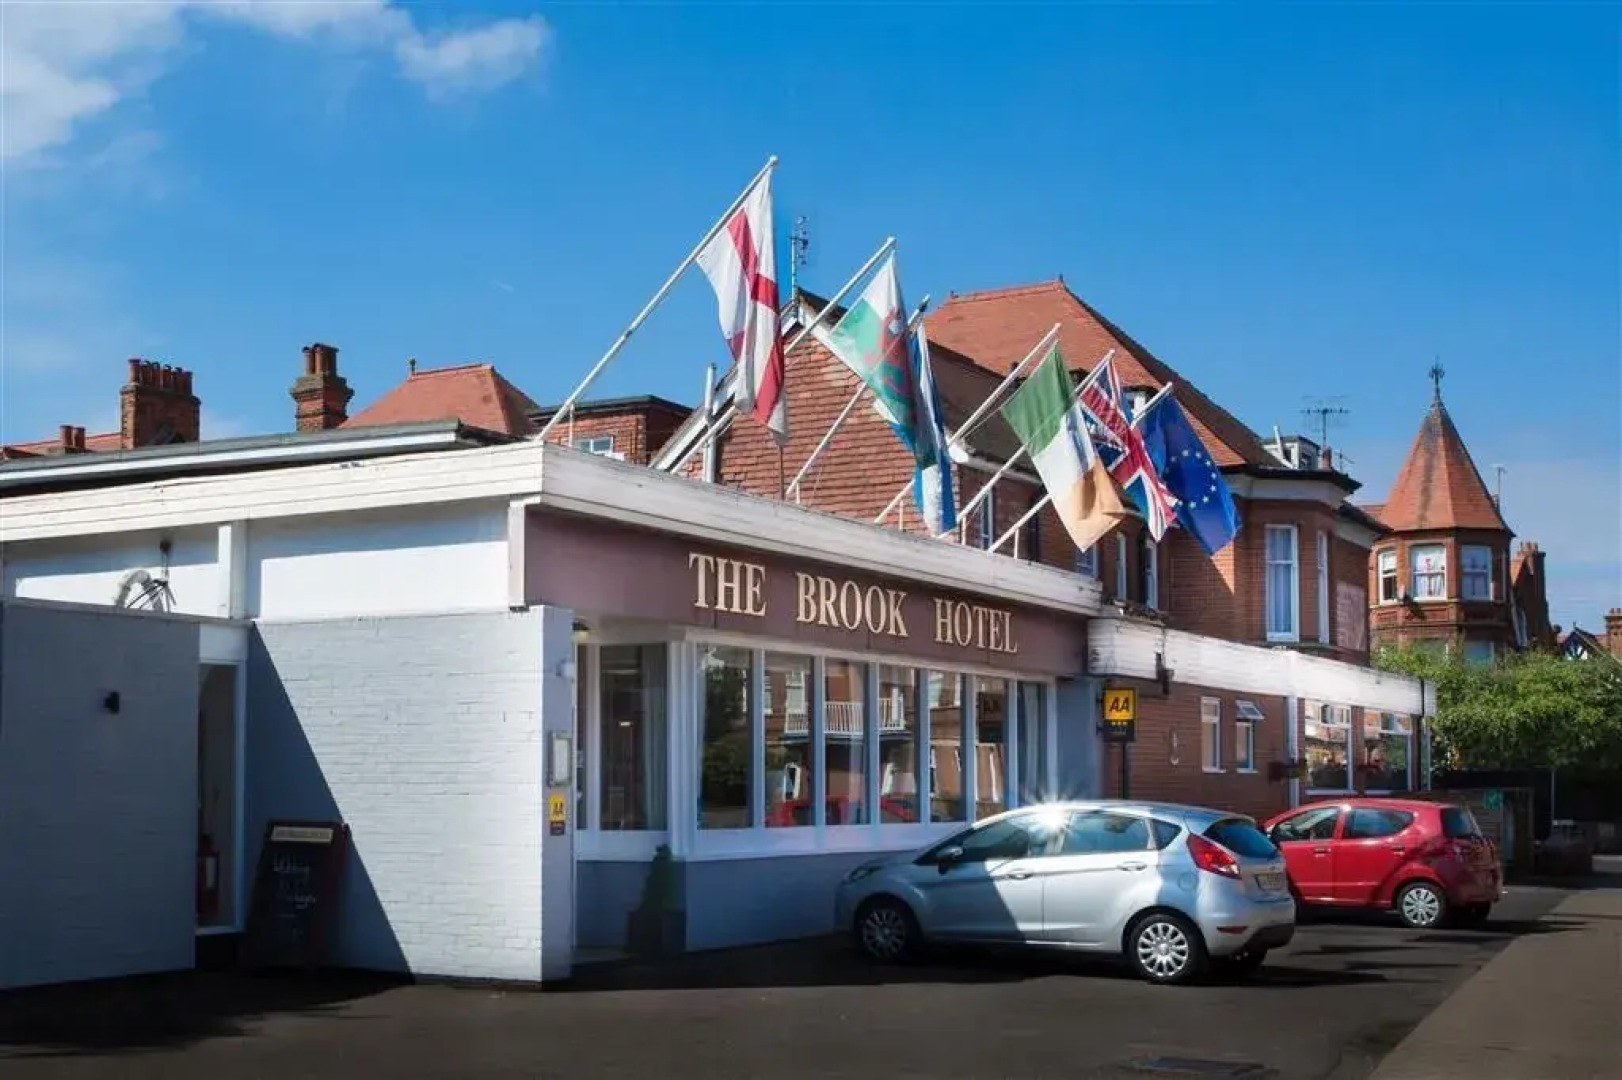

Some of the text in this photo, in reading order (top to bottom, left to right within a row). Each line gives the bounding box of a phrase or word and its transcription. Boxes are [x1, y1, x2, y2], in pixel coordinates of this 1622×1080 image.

[689, 552, 1018, 653] THE BROOK HOTEL
[1109, 696, 1129, 712] AA
